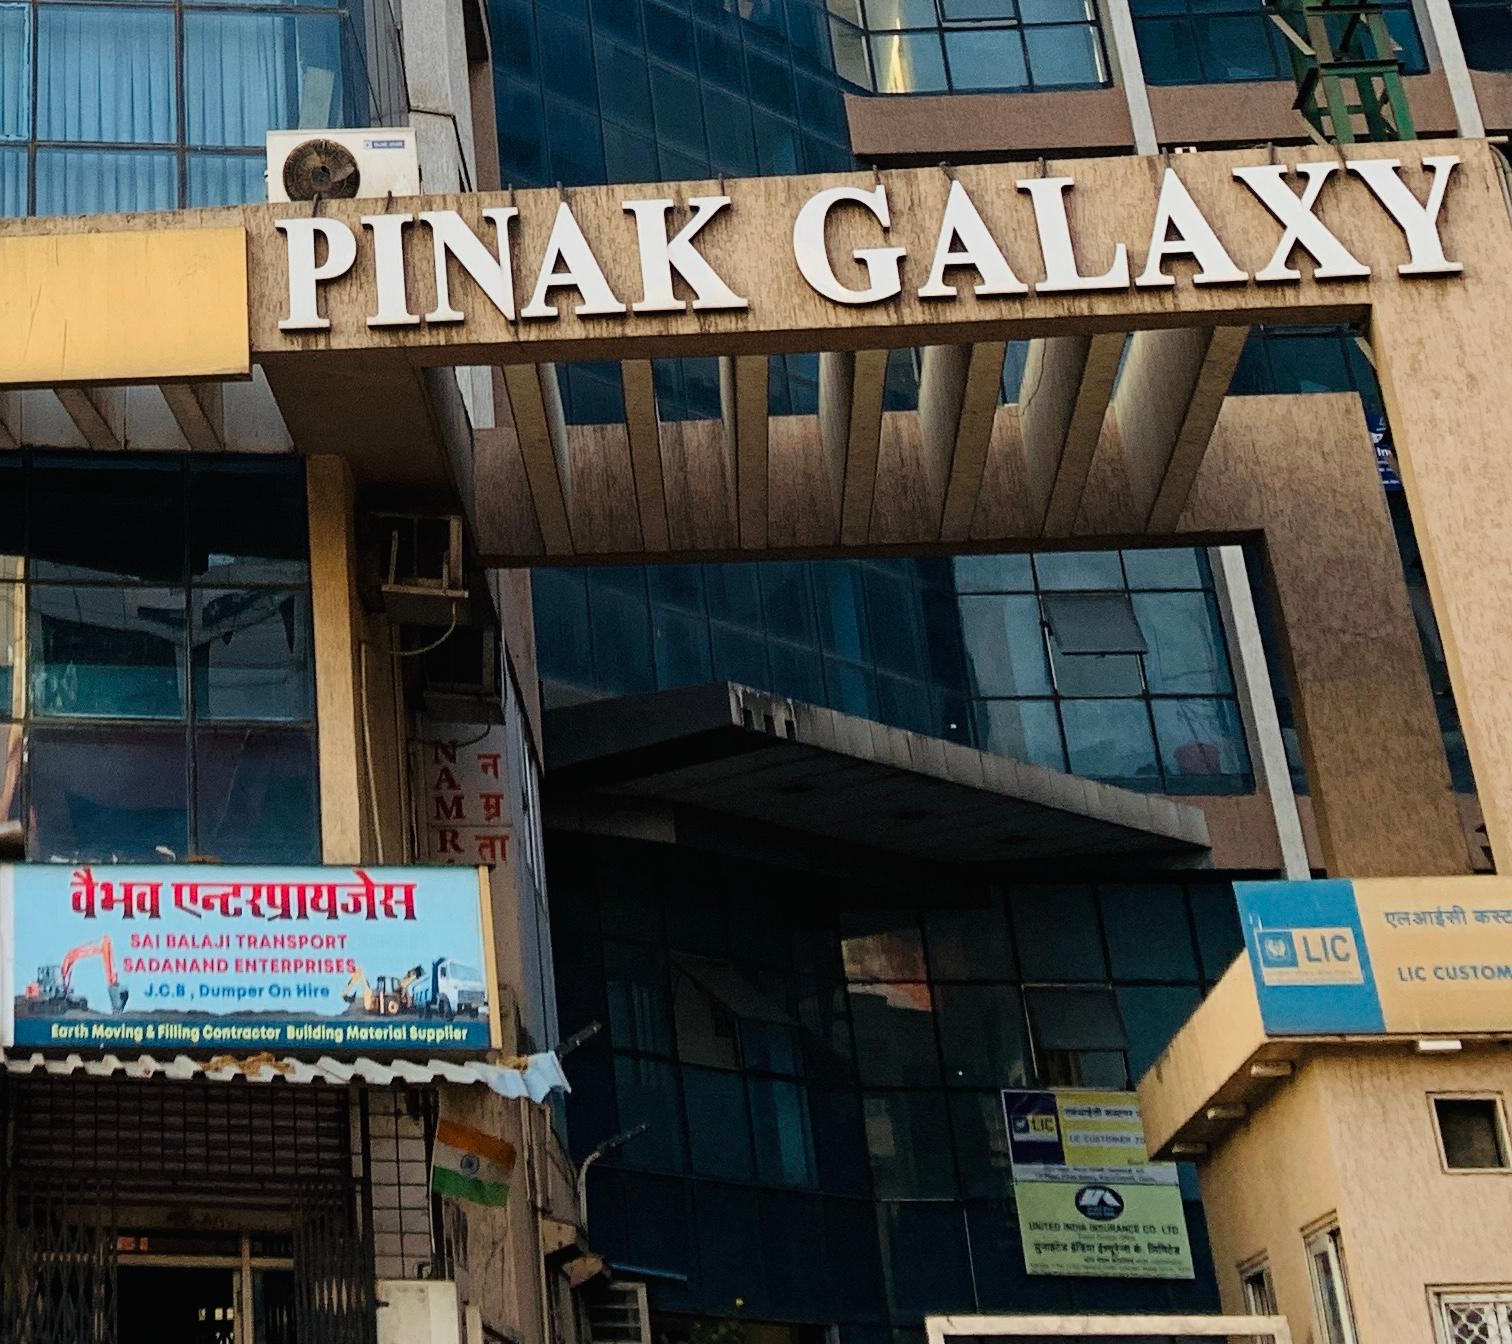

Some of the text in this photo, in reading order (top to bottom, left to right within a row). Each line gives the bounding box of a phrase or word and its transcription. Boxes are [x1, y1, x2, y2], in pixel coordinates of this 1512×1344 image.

[276, 155, 1462, 331] PINAK GALAXY
[70, 866, 417, 921] वैभव एन्टरप्रायजेस
[131, 934, 347, 950] SAI BALAJI TRANSPORT
[1302, 935, 1350, 963] LIC
[123, 958, 356, 973] SADANAND ENTERPRISES
[1397, 967, 1427, 982] LIC
[199, 983, 264, 1000] Dumper
[268, 984, 291, 998] On
[296, 983, 330, 998] Hire
[51, 1023, 281, 1042] Earth Moving & Filling Contractor
[287, 1025, 468, 1043] Building Material Supplier
[1089, 1224, 1141, 1234] INSURANCE
